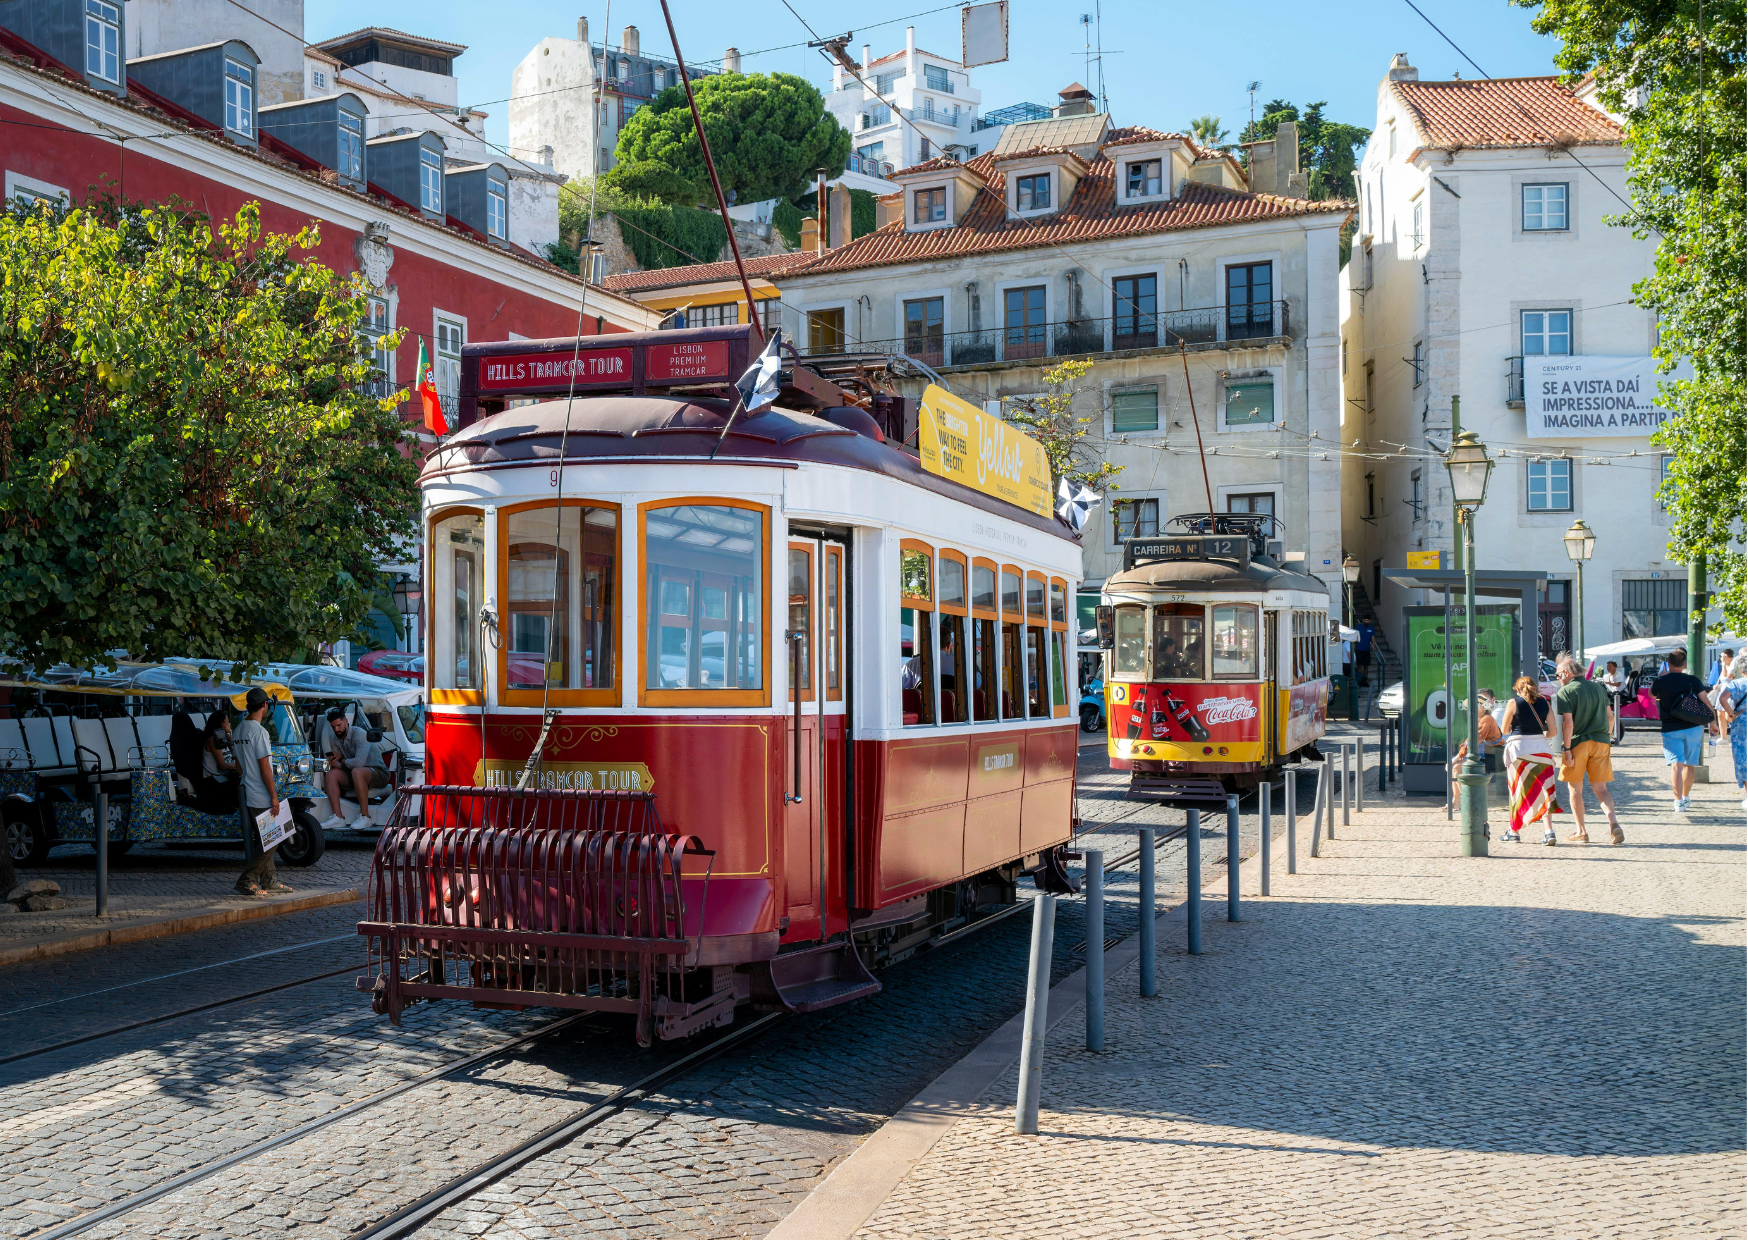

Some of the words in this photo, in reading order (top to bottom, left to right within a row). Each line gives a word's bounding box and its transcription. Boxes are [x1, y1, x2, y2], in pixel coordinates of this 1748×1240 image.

[673, 345, 703, 355] LISBON
[487, 363, 525, 381] HILLS
[529, 360, 586, 378] TRAMCAR
[589, 357, 623, 374] TOUR
[670, 355, 706, 366] PREMIUM
[670, 366, 706, 376] TRAMCAR
[1542, 381, 1558, 395] SE
[1561, 381, 1571, 395] A
[1573, 380, 1613, 394] VISTA
[1617, 375, 1640, 393] DAÍ
[936, 408, 945, 426] THE
[946, 412, 968, 437] BRIGHTER
[1544, 413, 1605, 428] IMAGINA
[1607, 413, 1618, 427] A
[1621, 412, 1667, 427] PARTIR
[938, 429, 949, 447] WAY
[950, 434, 957, 450] TO
[957, 437, 968, 455] FEEL
[975, 414, 1023, 485] Yellow
[943, 450, 952, 469] THE
[550, 470, 558, 487] 9
[1133, 545, 1182, 555] CARREIRA
[1214, 541, 1232, 554] 12
[487, 769, 525, 788] HILLS
[598, 770, 642, 790] TOUR
